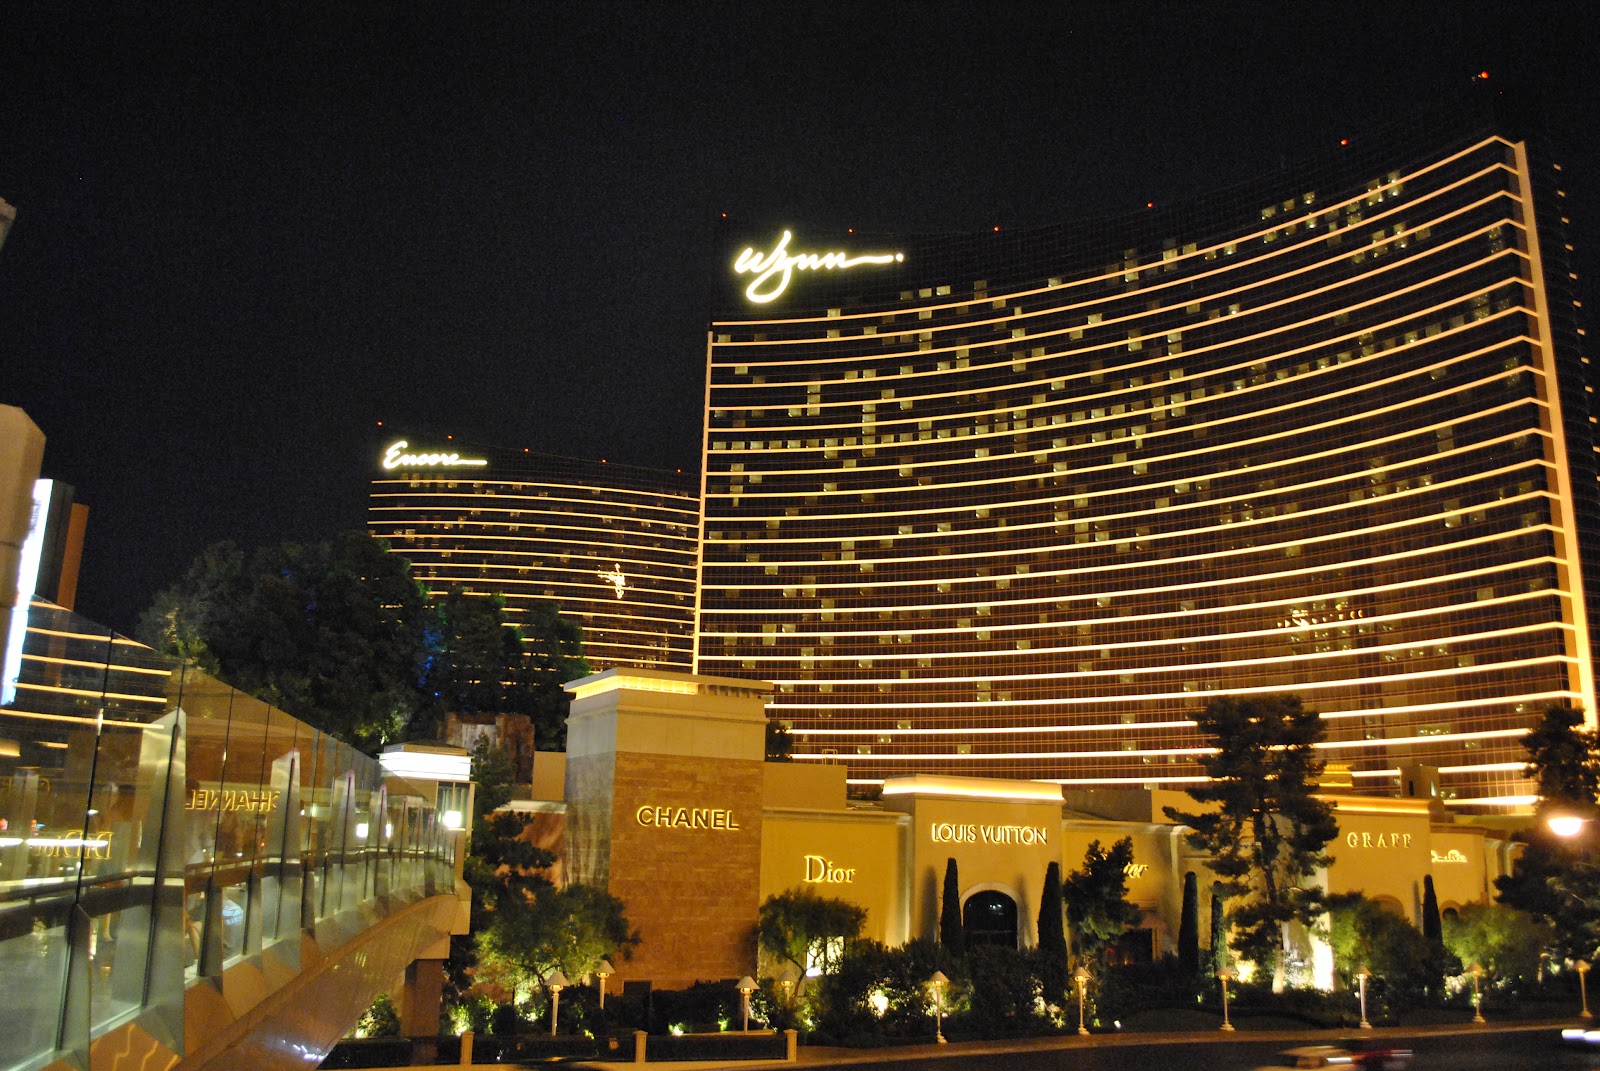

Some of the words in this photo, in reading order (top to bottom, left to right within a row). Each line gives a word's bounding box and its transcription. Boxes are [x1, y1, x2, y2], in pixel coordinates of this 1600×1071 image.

[636, 805, 740, 831] CHANEL
[931, 822, 977, 843] LOUIS
[980, 824, 1048, 846] VUITTON
[1346, 831, 1412, 849] GRAFF
[803, 854, 856, 883] Dior
